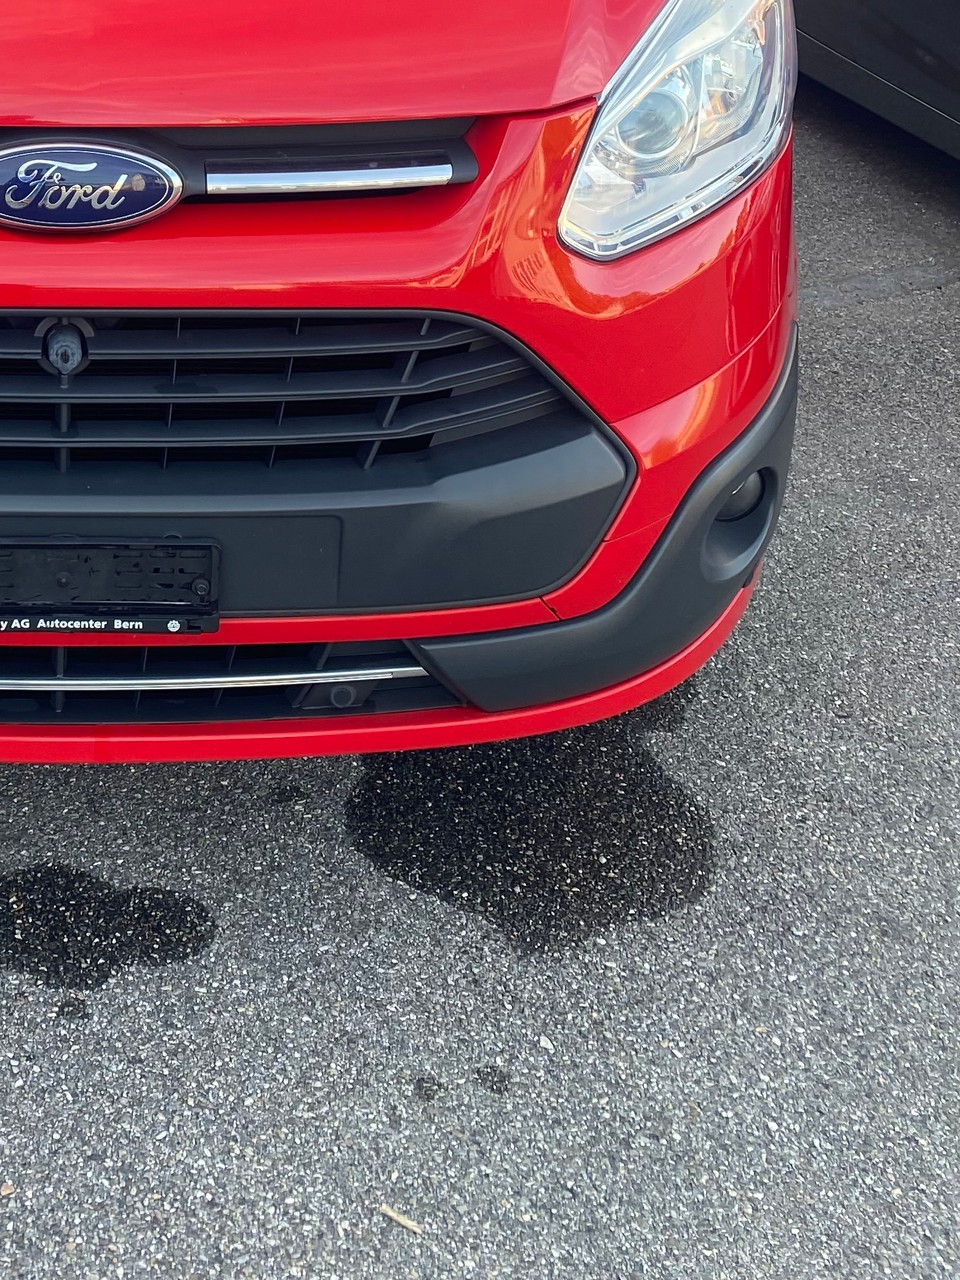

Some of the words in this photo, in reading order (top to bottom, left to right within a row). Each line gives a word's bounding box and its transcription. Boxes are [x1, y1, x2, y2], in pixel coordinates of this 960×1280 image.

[5, 159, 127, 210] Ford
[10, 618, 30, 630] AG
[36, 618, 108, 630] Autocenter
[113, 618, 143, 630] Bern
